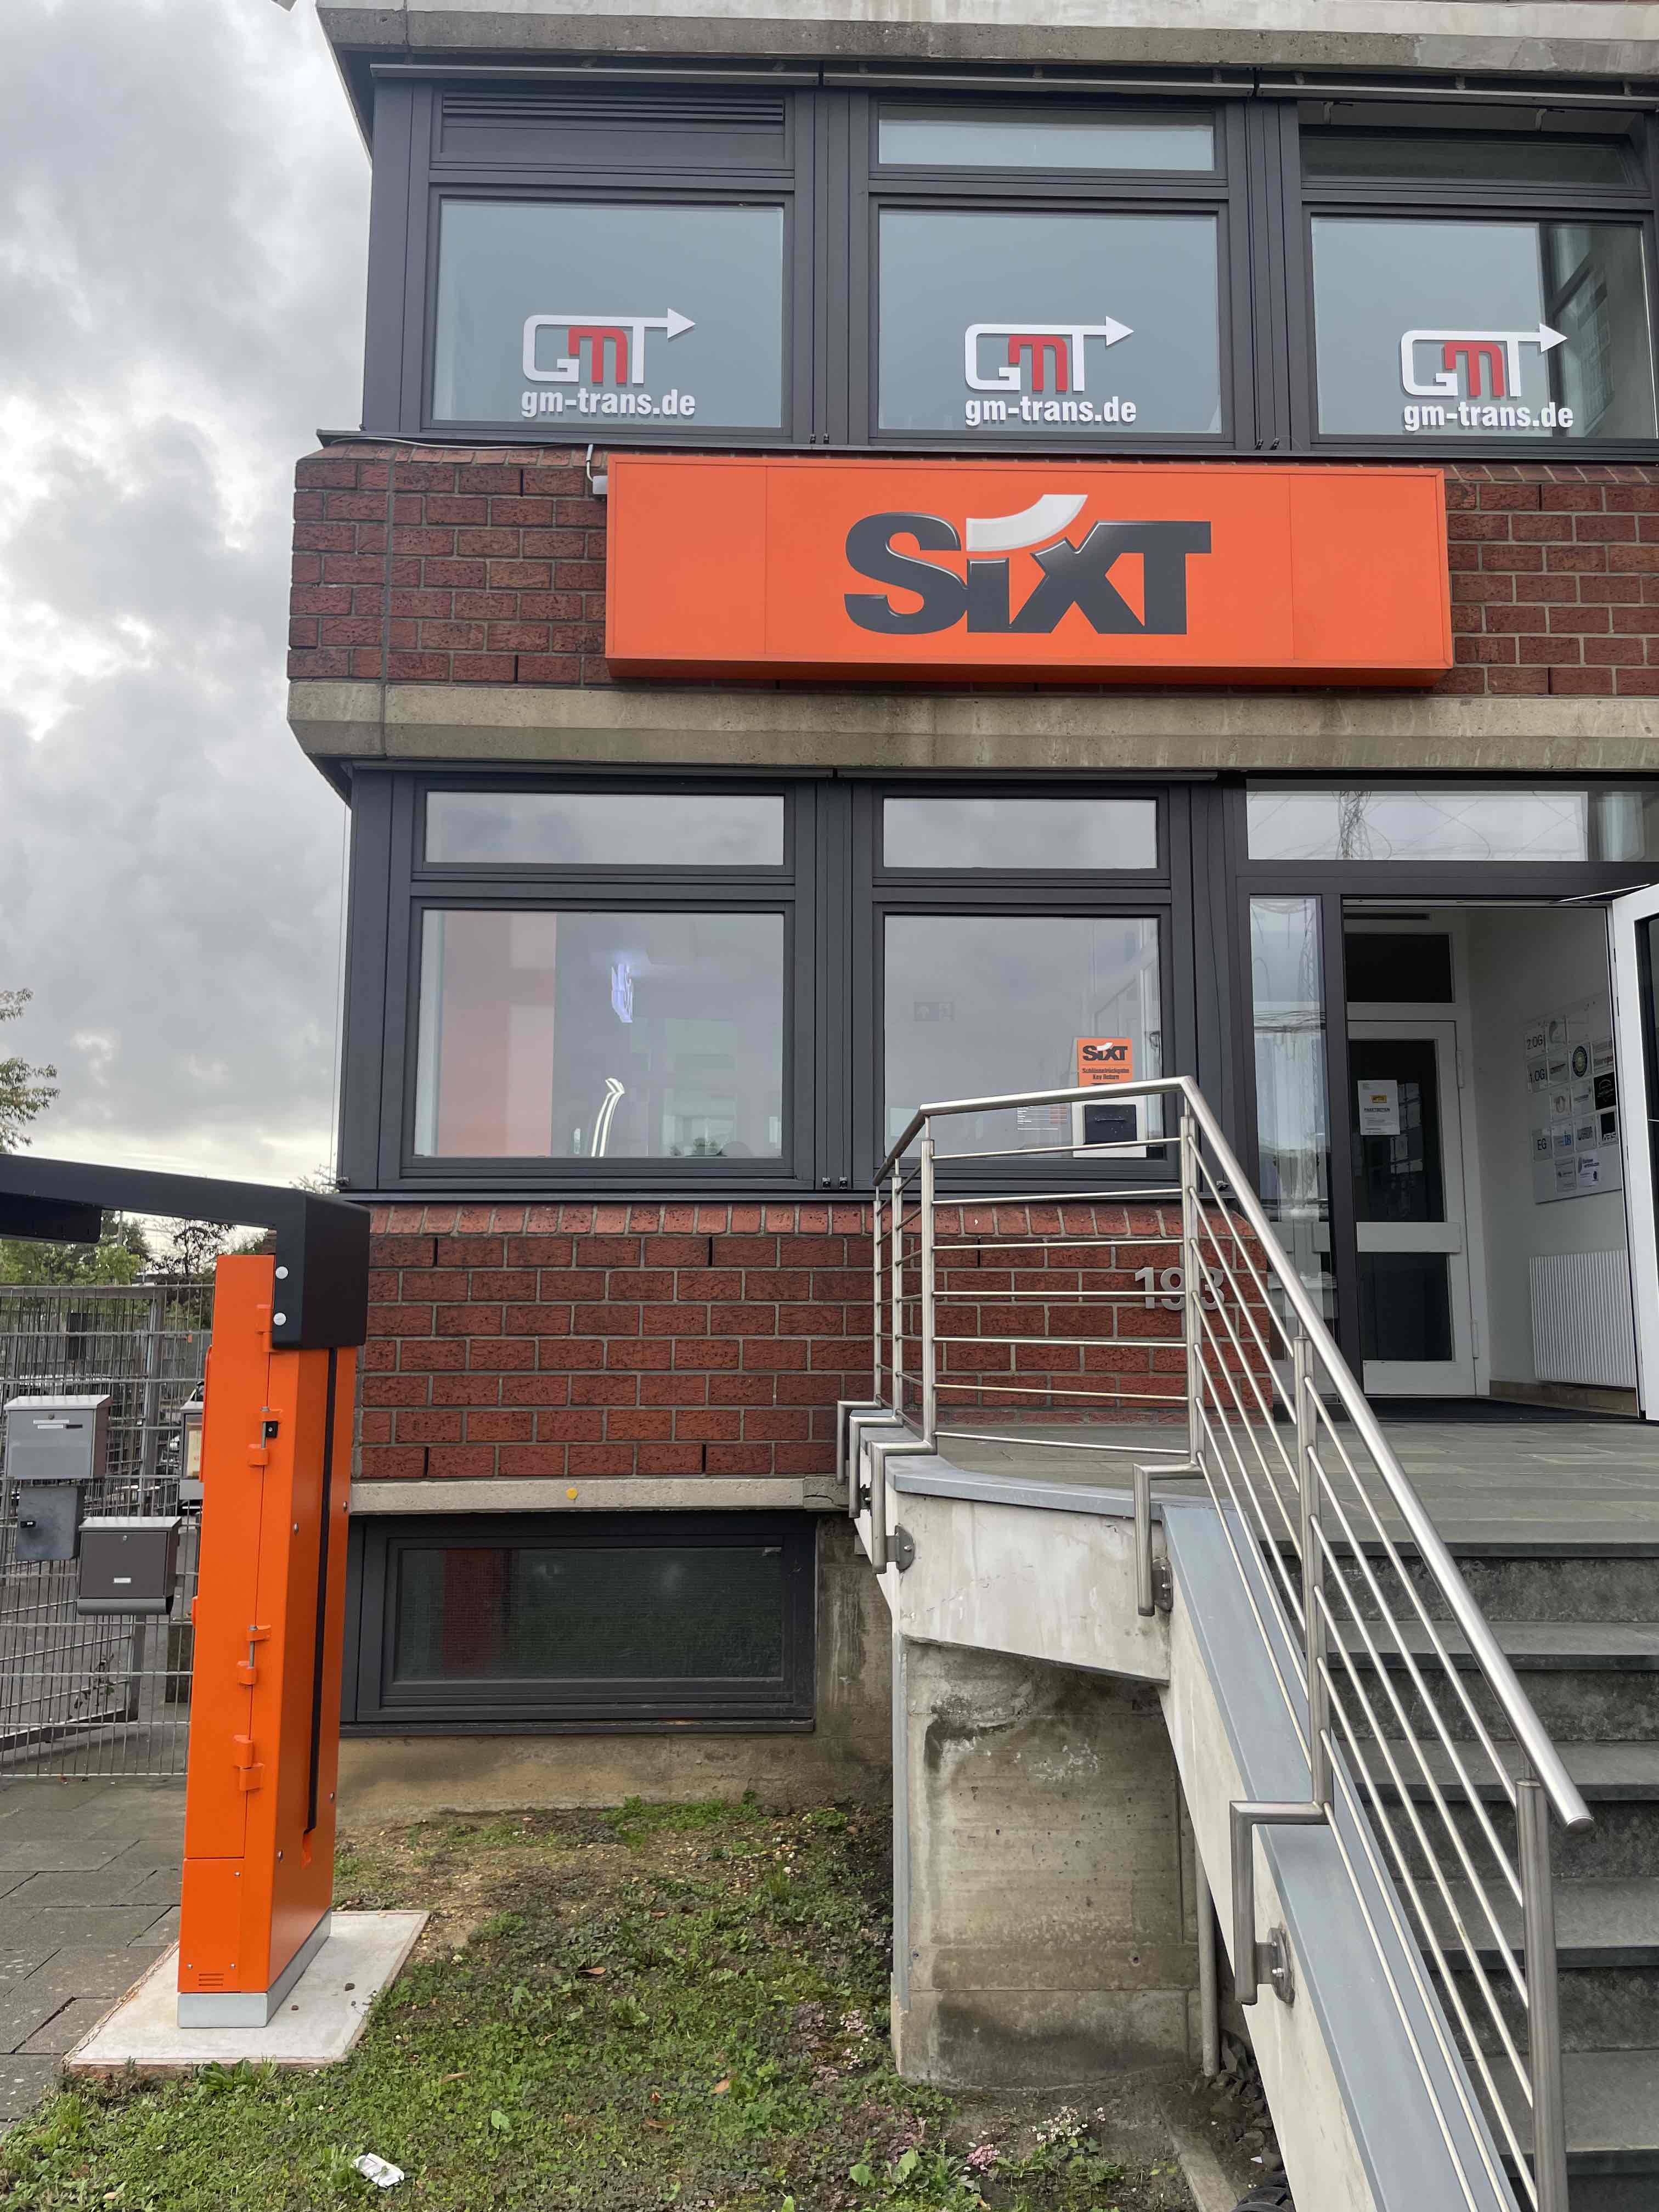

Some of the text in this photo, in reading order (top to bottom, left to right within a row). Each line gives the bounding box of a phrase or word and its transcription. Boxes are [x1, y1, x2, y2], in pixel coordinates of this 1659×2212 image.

[522, 388, 696, 417] gm-trans.de
[965, 396, 1137, 426] gm-trans.de
[1404, 402, 1573, 431] gm-trans.de
